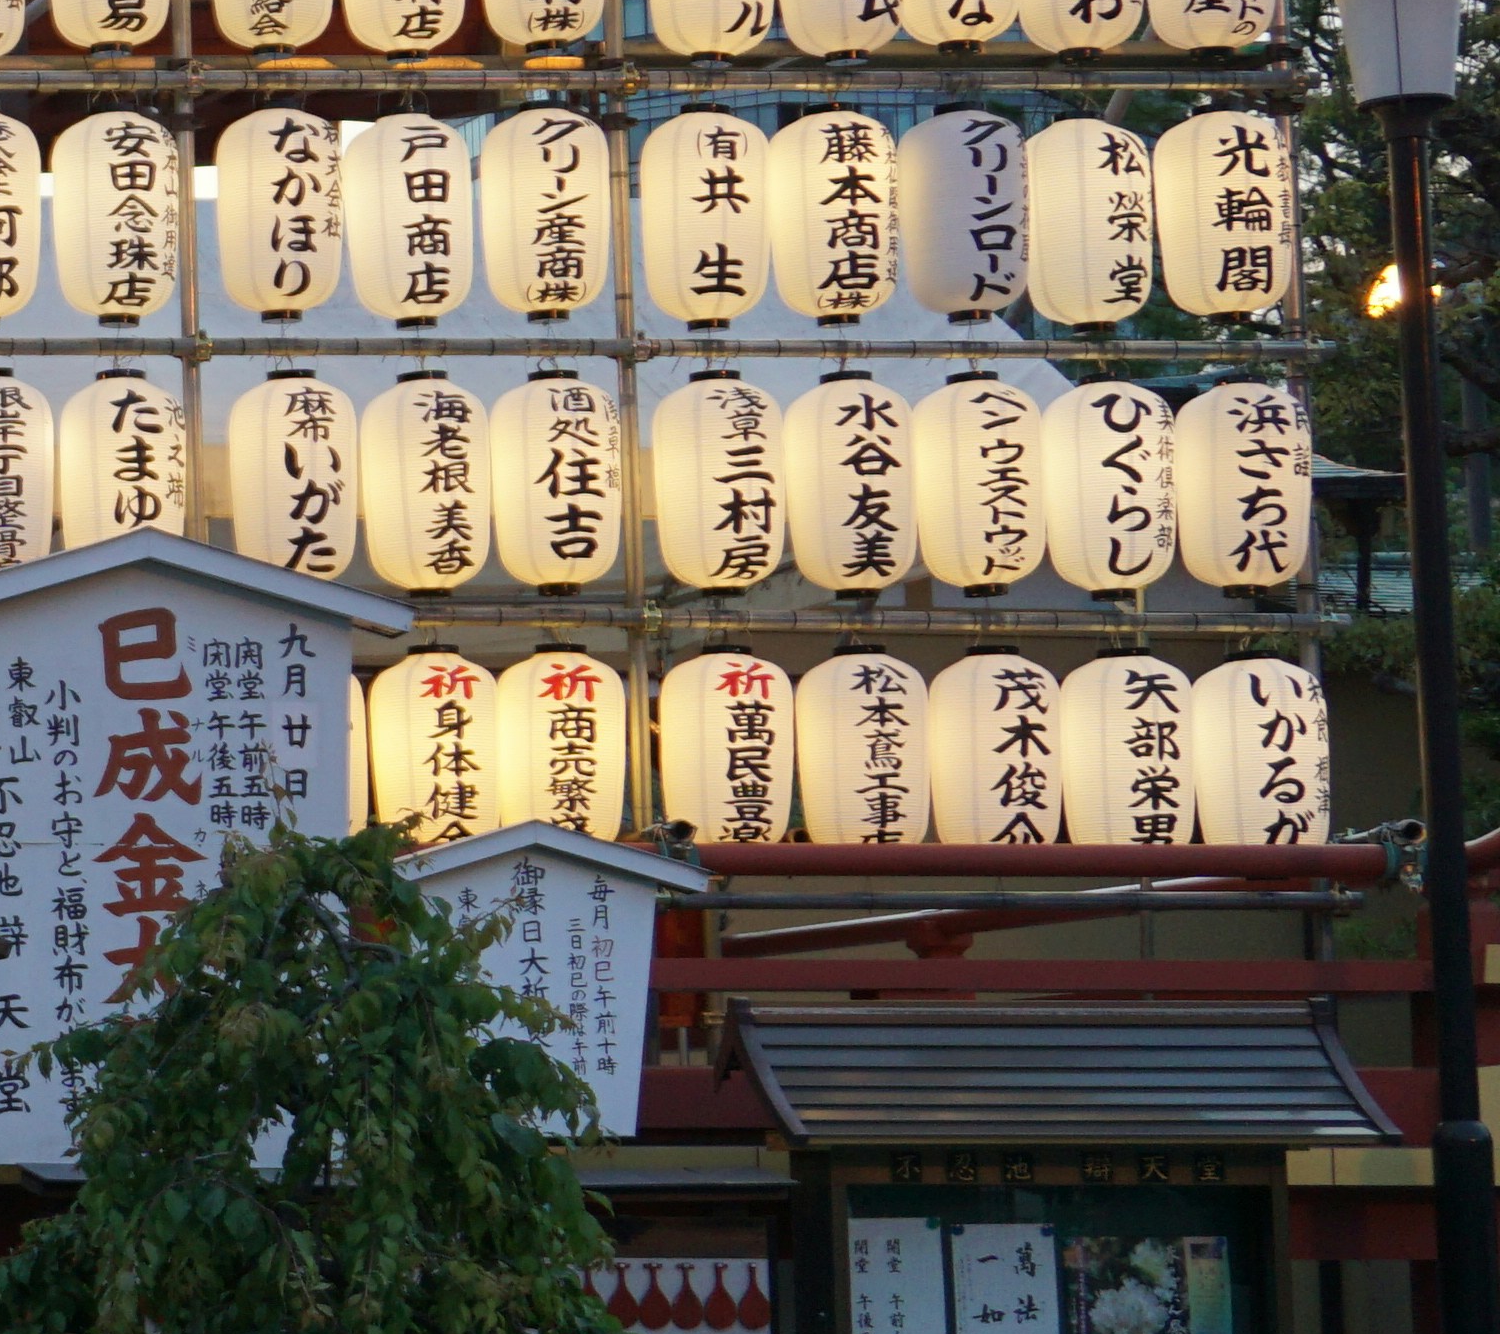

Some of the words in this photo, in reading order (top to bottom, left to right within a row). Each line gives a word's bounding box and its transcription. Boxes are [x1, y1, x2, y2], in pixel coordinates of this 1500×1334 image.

[836, 393, 901, 577] 水谷友美
[1091, 394, 1152, 576] ひぐらし
